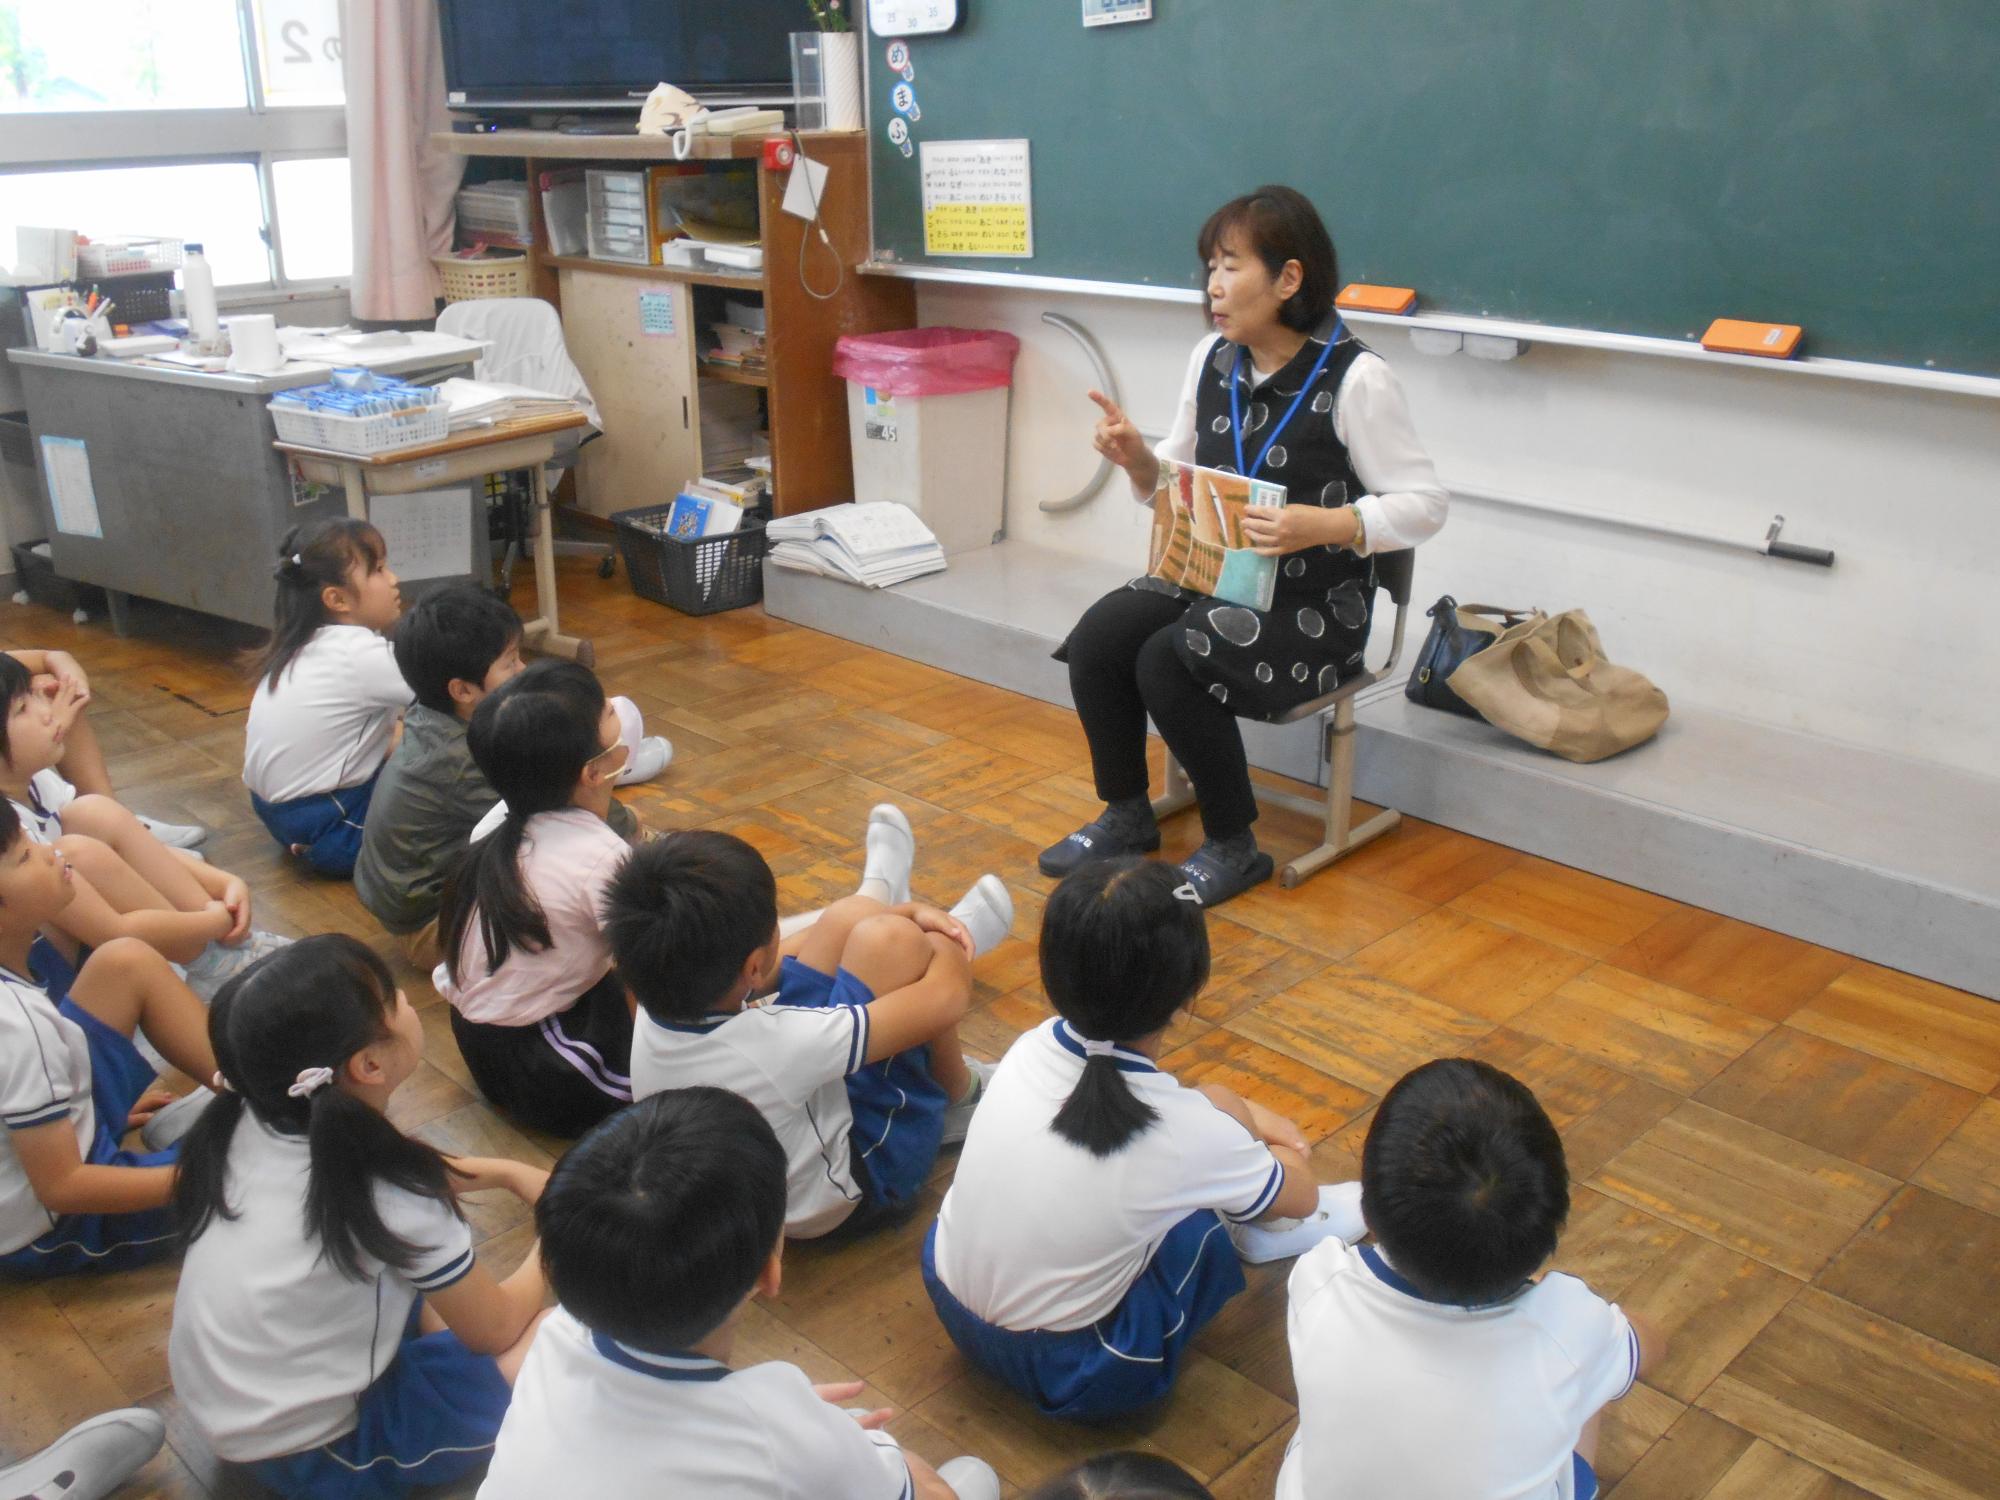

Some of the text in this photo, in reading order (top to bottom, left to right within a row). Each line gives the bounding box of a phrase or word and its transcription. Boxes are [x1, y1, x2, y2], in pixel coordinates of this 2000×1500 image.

[891, 46, 904, 63] め
[896, 88, 909, 107] ま
[891, 121, 906, 140] ふ
[881, 425, 896, 441] 45
